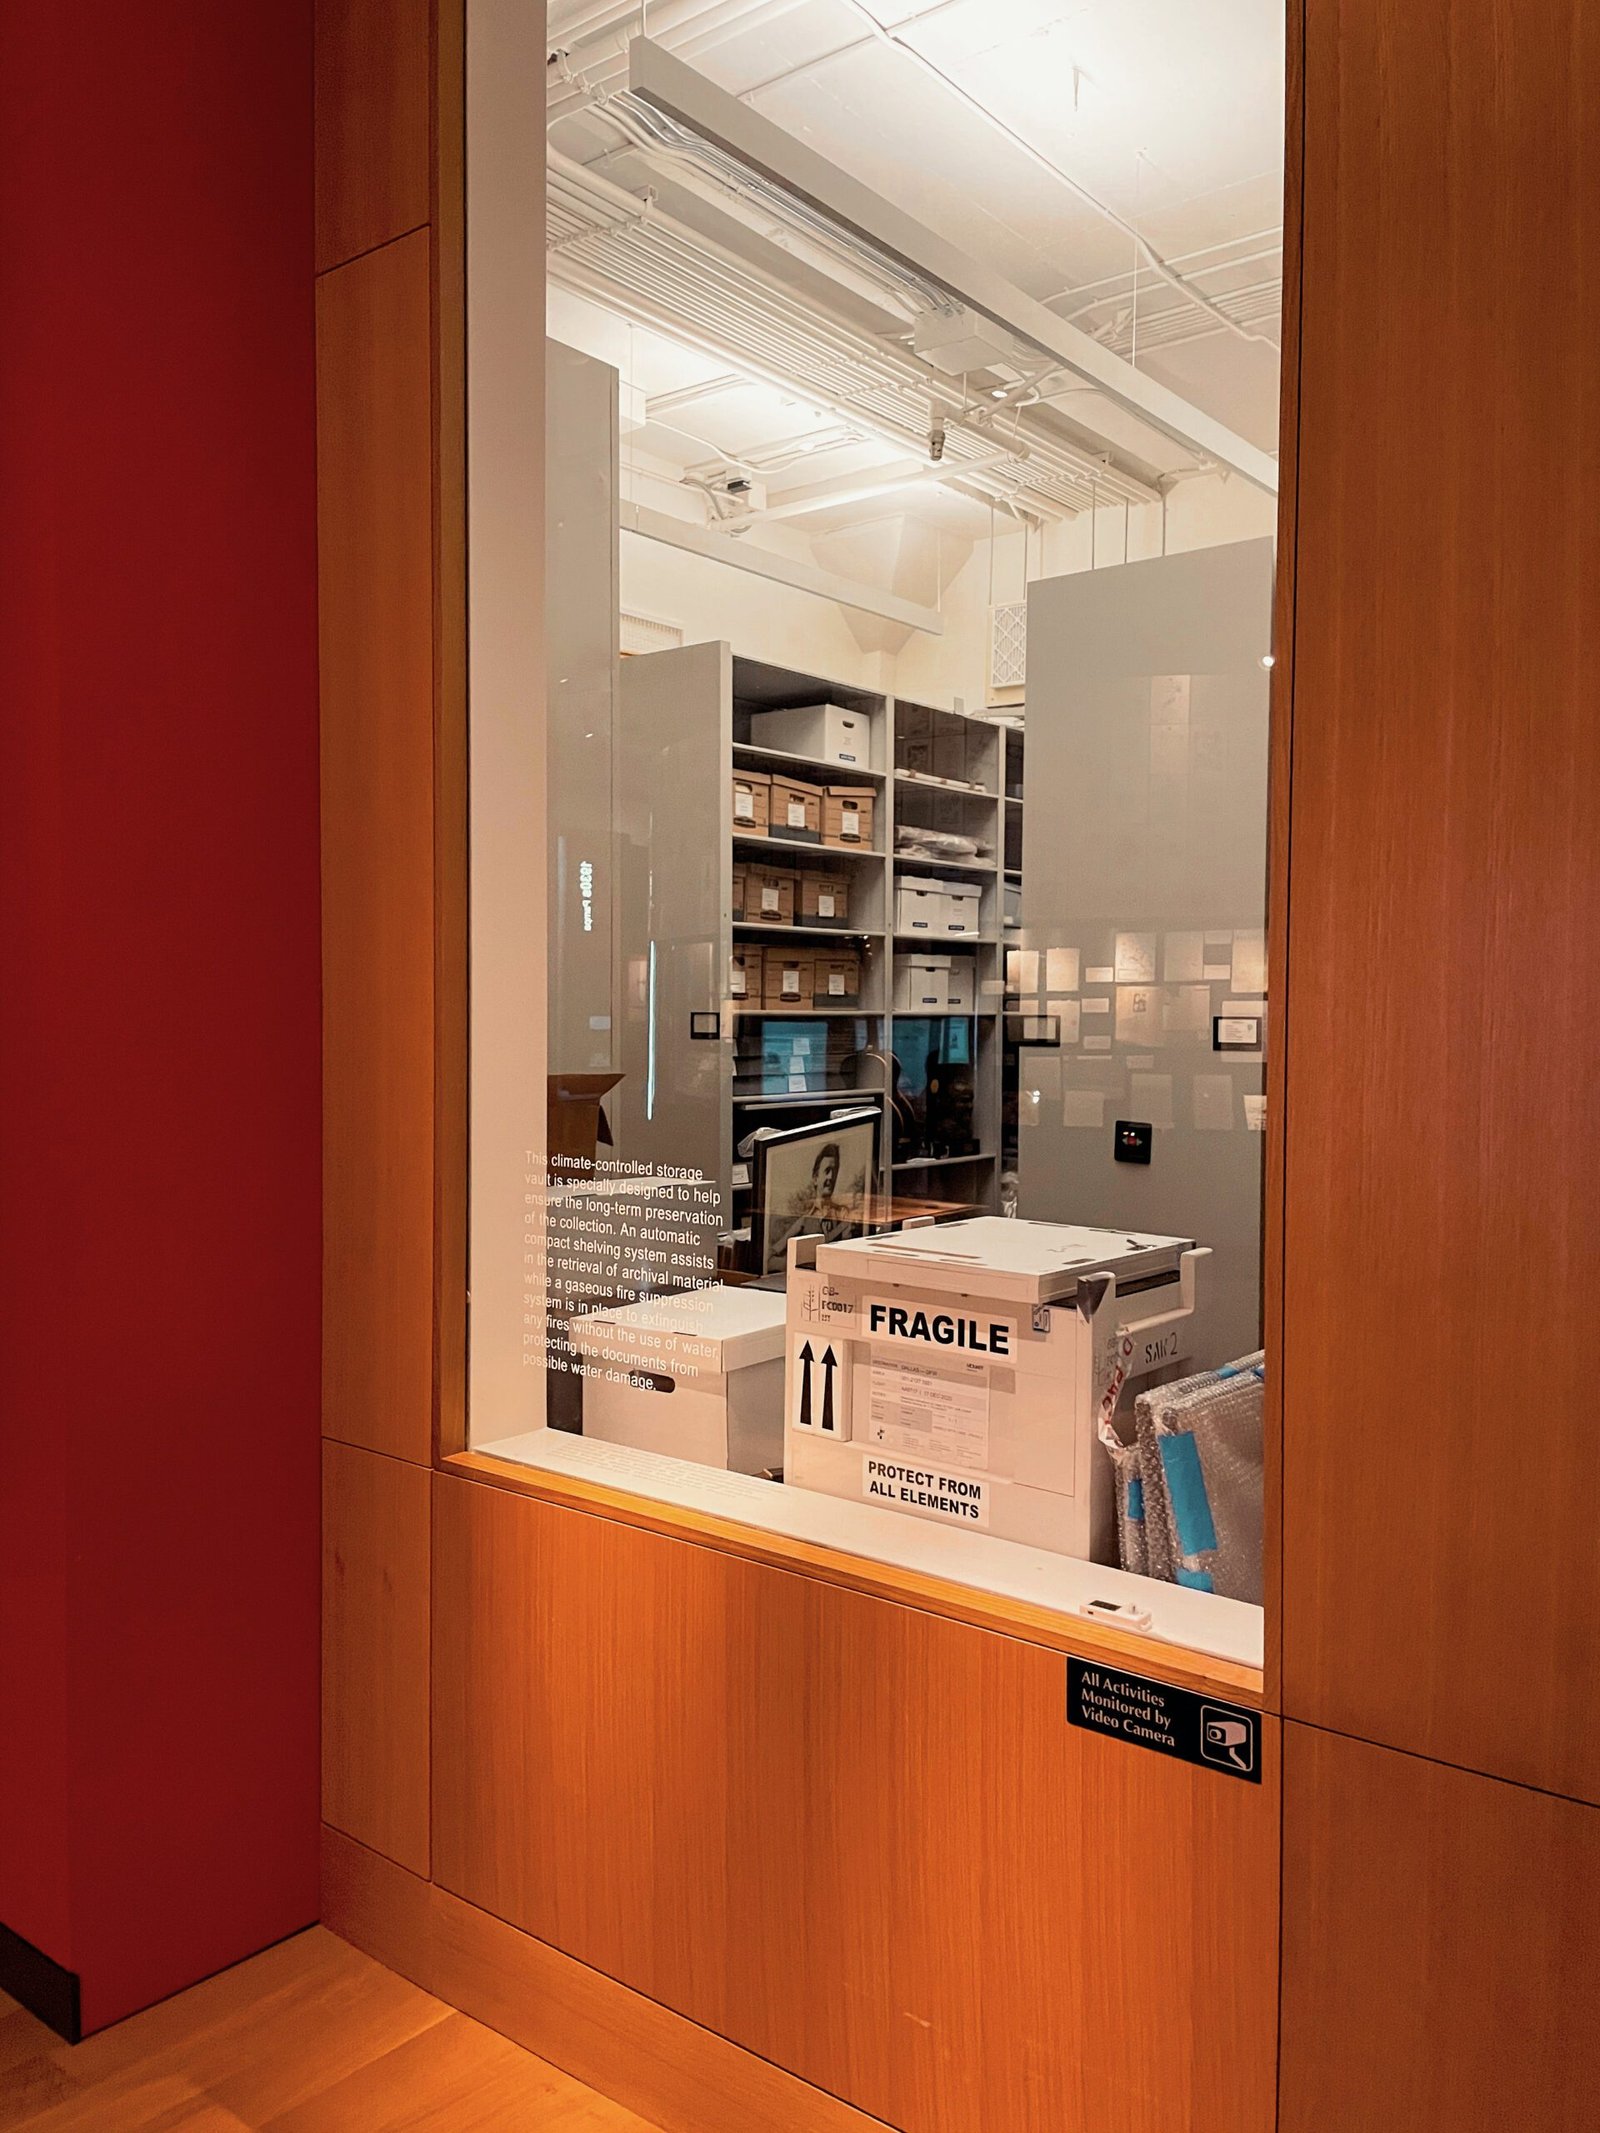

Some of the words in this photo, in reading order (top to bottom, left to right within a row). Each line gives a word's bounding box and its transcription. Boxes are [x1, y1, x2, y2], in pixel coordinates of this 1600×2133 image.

[526, 1151, 547, 1165] This
[552, 1154, 652, 1176] climate-controlled
[656, 1163, 703, 1181] storage
[525, 1173, 550, 1186] vault
[554, 1176, 563, 1186] is
[567, 1178, 616, 1196] specially
[619, 1182, 674, 1200] designed
[677, 1188, 690, 1201] to
[693, 1190, 721, 1207] help
[525, 1193, 562, 1208] ensure
[565, 1196, 583, 1210] the
[586, 1199, 641, 1217] long-term
[645, 1207, 723, 1227] preservation
[524, 1212, 535, 1225] of
[539, 1214, 556, 1226] the
[560, 1216, 616, 1235] collection.
[620, 1224, 636, 1238] An
[640, 1227, 701, 1246] automatic
[524, 1233, 570, 1251] compact
[573, 1238, 621, 1259] shelving
[624, 1246, 667, 1263] system
[670, 1252, 714, 1270] assists
[524, 1253, 534, 1264] in
[537, 1254, 554, 1268] the
[557, 1258, 602, 1275] retrieval
[606, 1264, 618, 1277] of
[621, 1268, 669, 1286] archival
[524, 1273, 551, 1287] while
[554, 1278, 562, 1289] a
[565, 1278, 613, 1298] gaseous
[616, 1285, 635, 1301] fire
[639, 1290, 714, 1314] suppression
[524, 1293, 562, 1310] system
[565, 1300, 575, 1312] is
[578, 1301, 588, 1313] in
[591, 1303, 622, 1321] place
[626, 1310, 637, 1322] to
[642, 1312, 704, 1333] extinguish
[870, 1304, 1009, 1355] FRAGILE
[523, 1314, 543, 1330] any
[546, 1316, 569, 1331] fires
[573, 1320, 615, 1340] without
[617, 1327, 636, 1343] the
[640, 1333, 660, 1348] use
[665, 1338, 677, 1351] of
[1170, 1332, 1178, 1355] 2
[523, 1333, 577, 1356] protecting
[580, 1343, 598, 1357] the
[602, 1346, 666, 1371] documents
[670, 1359, 699, 1377] from
[523, 1354, 568, 1372] possible
[571, 1361, 603, 1379] water
[605, 1367, 657, 1391] damage.
[869, 1461, 933, 1488] PROTECT
[939, 1477, 981, 1500] FROM
[870, 1481, 895, 1498] ALL
[900, 1487, 979, 1519] ELEMENTS
[1081, 1672, 1099, 1687] All
[1103, 1678, 1165, 1707] Activities
[1081, 1688, 1150, 1721] Monitored
[1155, 1709, 1171, 1730] by
[1081, 1705, 1119, 1728] Video
[1123, 1720, 1175, 1747] Camera
